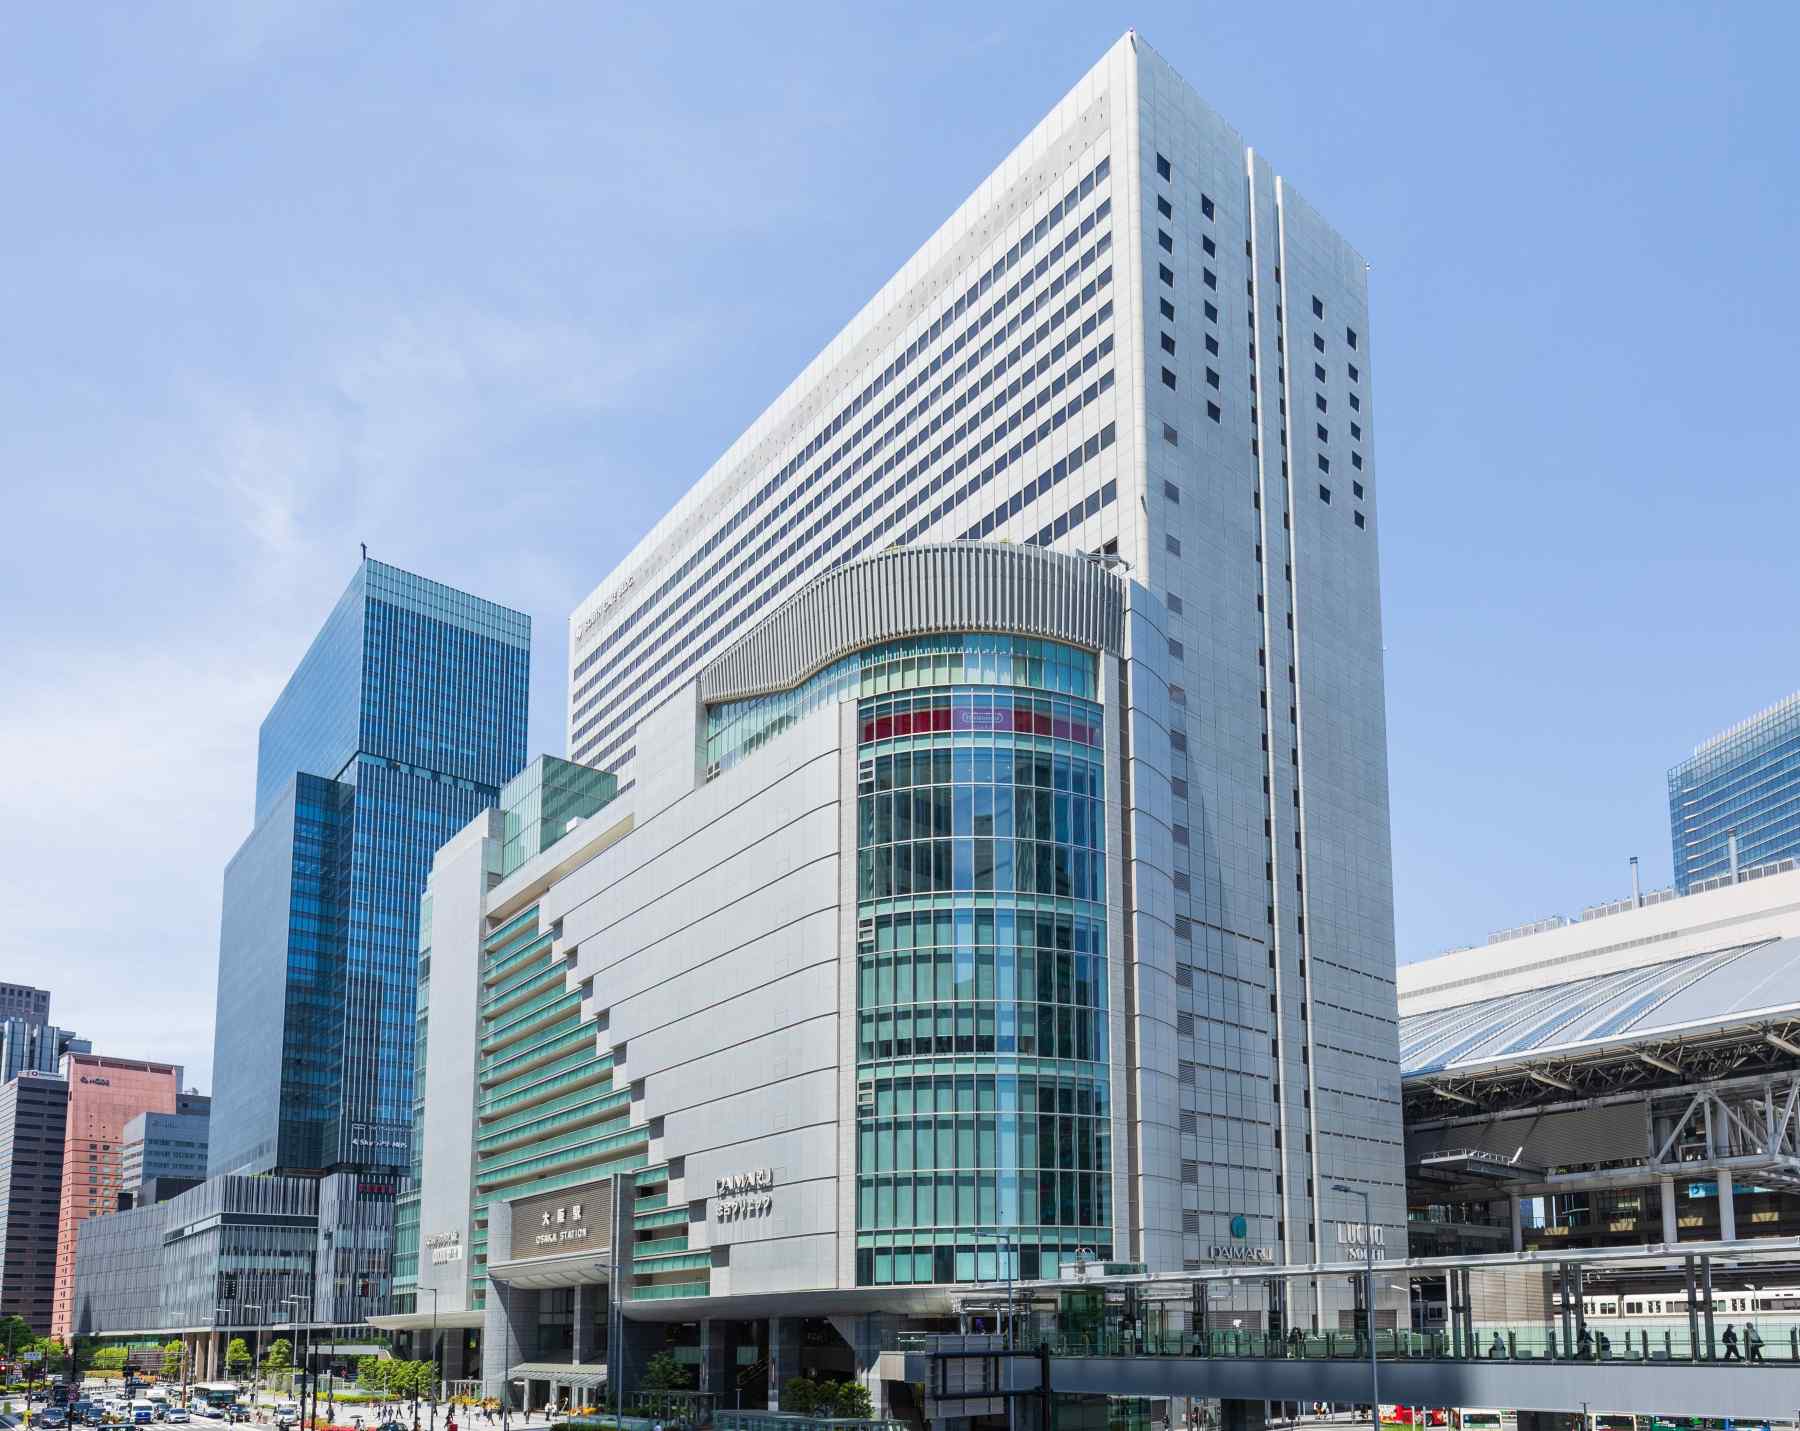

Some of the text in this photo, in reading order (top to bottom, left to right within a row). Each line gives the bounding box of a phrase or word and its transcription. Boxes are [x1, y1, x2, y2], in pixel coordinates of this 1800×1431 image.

[714, 1168, 773, 1199] DAIMARU
[535, 1227, 587, 1244] OSAKA STATION
[1209, 1246, 1273, 1260] DAIMARU
